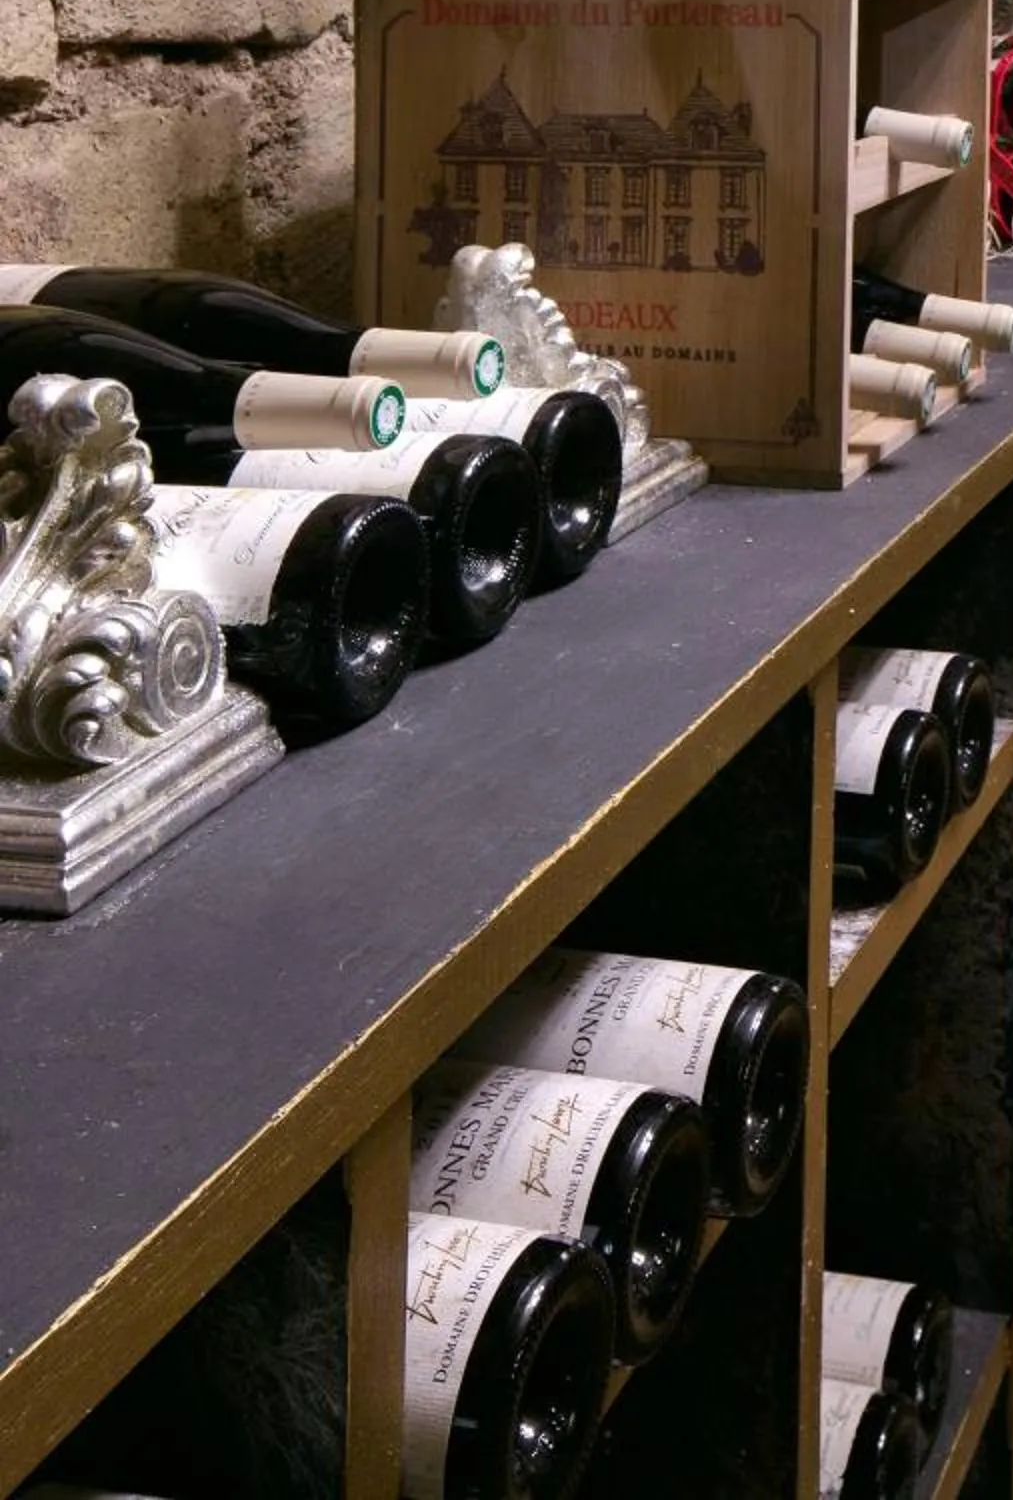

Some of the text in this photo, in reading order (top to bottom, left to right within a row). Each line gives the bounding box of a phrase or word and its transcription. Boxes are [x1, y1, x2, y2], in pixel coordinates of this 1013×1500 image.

[557, 301, 678, 332] RDEAUX
[652, 346, 737, 363] DOMAINE
[565, 975, 622, 1076] BONNES
[429, 1117, 482, 1216] ONNES
[471, 1114, 510, 1181] GRAND
[559, 1178, 581, 1236] OMAINE
[432, 1305, 471, 1384] DOMAINE
